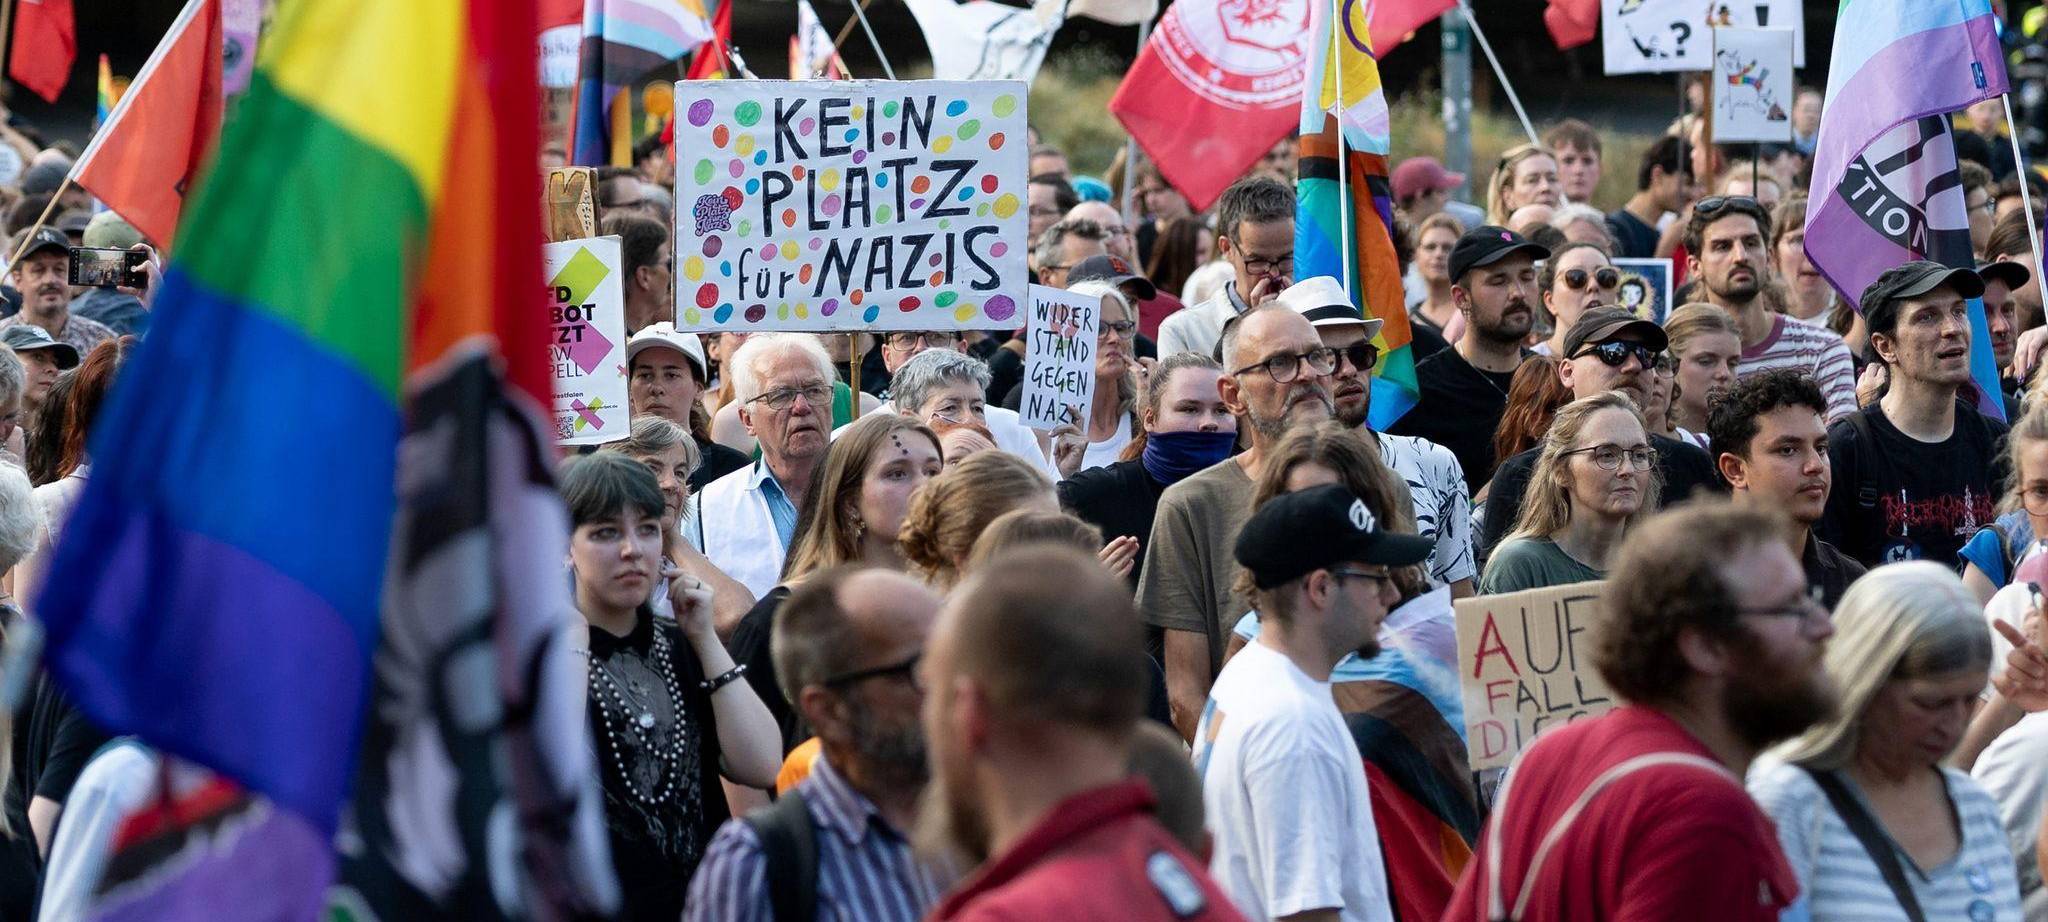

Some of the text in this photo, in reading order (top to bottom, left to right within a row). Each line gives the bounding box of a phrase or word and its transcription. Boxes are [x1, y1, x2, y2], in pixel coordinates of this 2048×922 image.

[774, 95, 936, 163] KEIN
[762, 156, 978, 237] PLATZ
[1840, 163, 1929, 253] TION
[739, 225, 1000, 300] für NAZIS
[549, 303, 596, 323] BOT
[1036, 298, 1093, 333] WIDER
[1035, 328, 1089, 363] STAND
[1031, 361, 1088, 397] GEGEN
[1474, 595, 1600, 680] AUF
[1486, 675, 1610, 715] FALL
